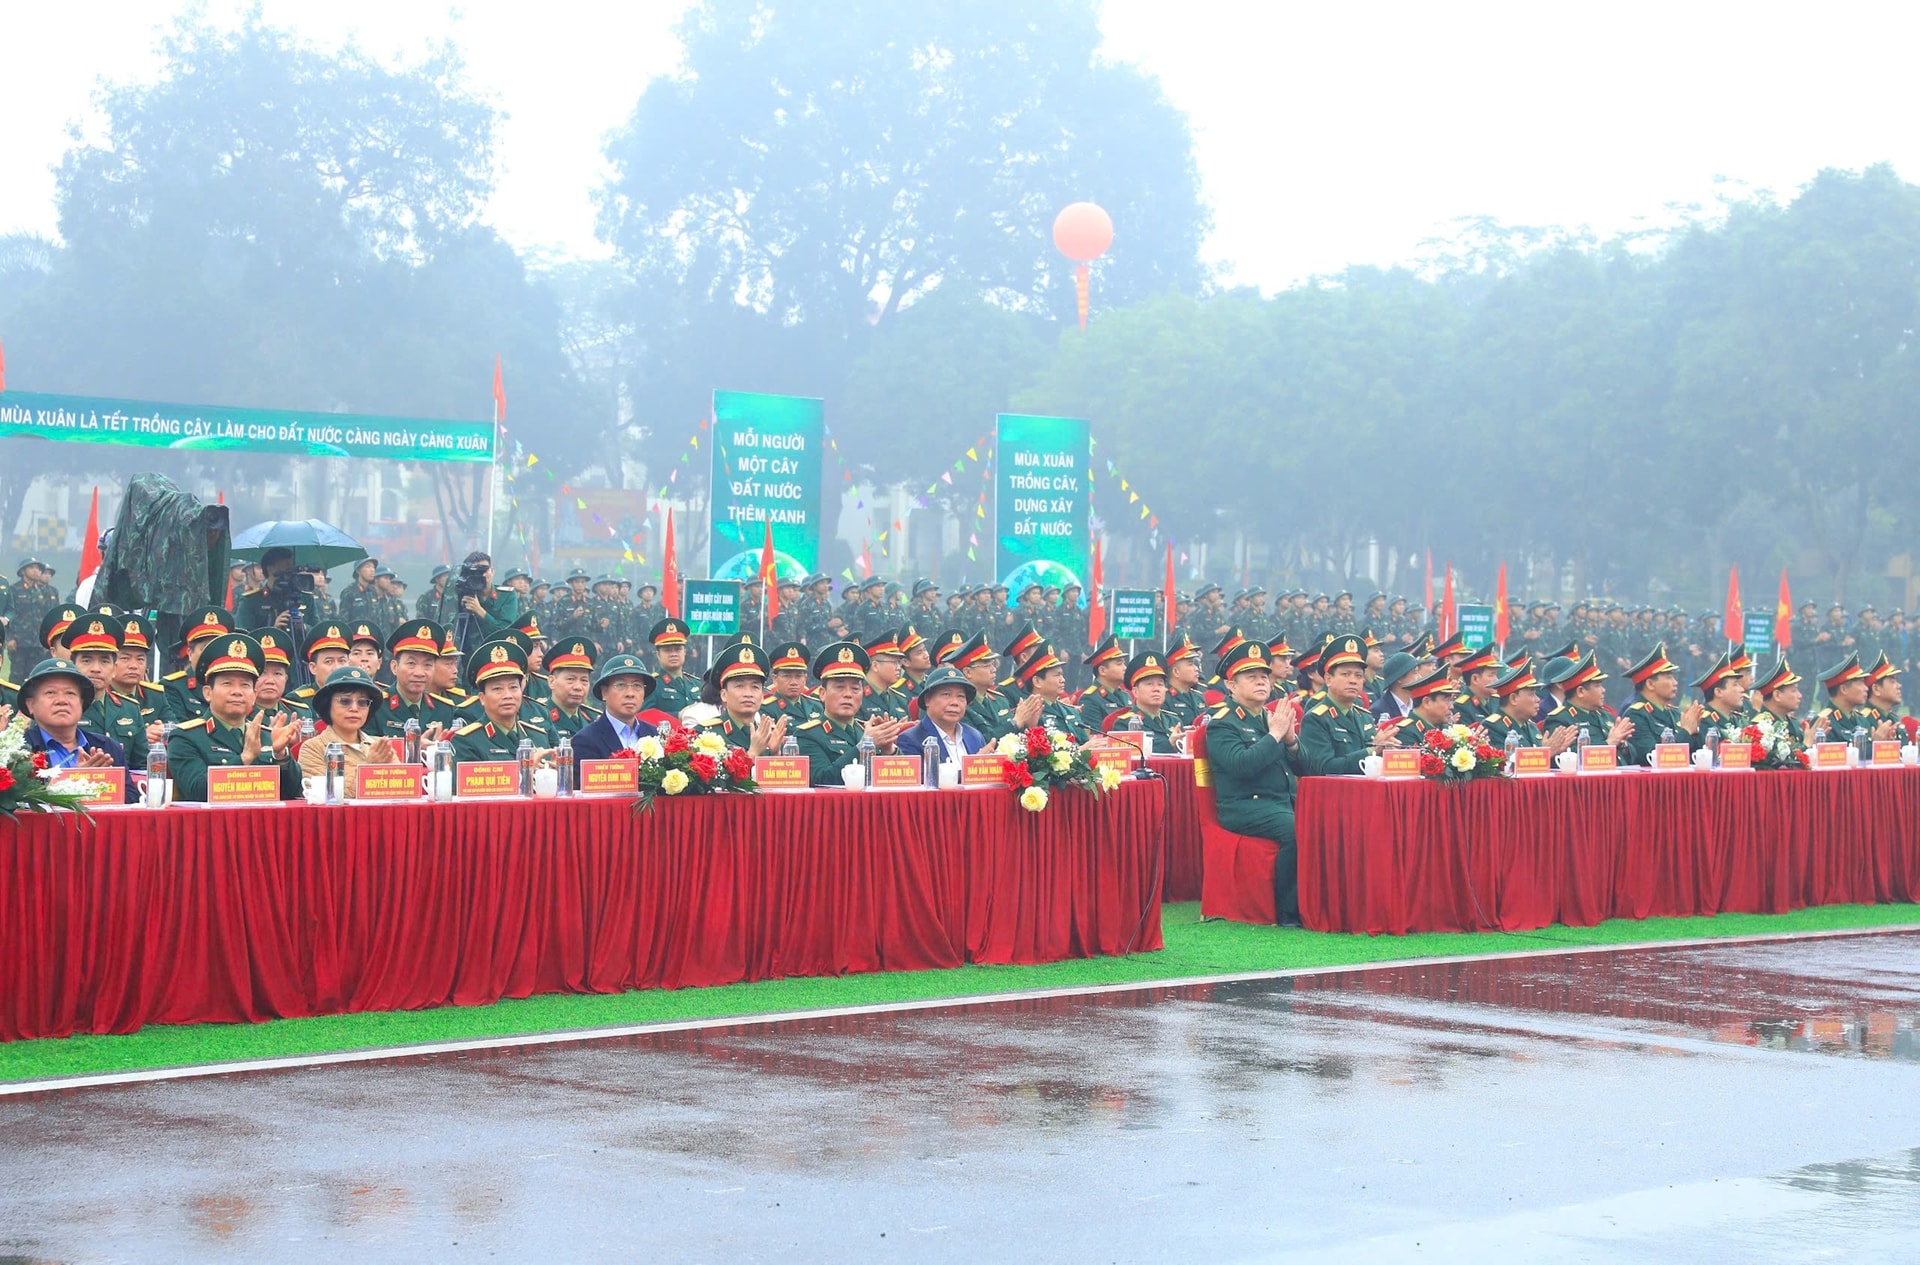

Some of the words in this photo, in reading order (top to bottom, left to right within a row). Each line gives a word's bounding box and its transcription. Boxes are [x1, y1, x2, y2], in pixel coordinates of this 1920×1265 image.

[1, 405, 33, 424] MÙA
[37, 408, 76, 427] XUÂN
[80, 410, 98, 429] LÀ
[102, 409, 129, 431] TẾT
[132, 412, 180, 434] TRỒNG
[184, 418, 213, 438] CÂY,
[217, 420, 244, 438] LÀM
[248, 424, 276, 440] CHO
[279, 421, 304, 441] ĐẤT
[307, 426, 342, 443] NƯỚC
[346, 426, 380, 446] CÀNG
[384, 428, 416, 447] NGÀY
[420, 430, 453, 448] CÀNG
[457, 433, 488, 450] XUÂN
[733, 427, 759, 447] MỖI
[762, 432, 805, 451] NGƯỜI
[738, 455, 768, 475] MỘT
[771, 457, 798, 475] CÂY
[1014, 450, 1040, 466] MÙA
[1043, 452, 1074, 468] XUÂN
[733, 477, 761, 496] ĐẤT
[764, 482, 802, 500] NƯỚC
[1053, 475, 1078, 493] CÂY,
[728, 504, 766, 522] THÊM
[769, 508, 806, 524] XANH
[1014, 498, 1048, 514] DỰNG
[1050, 497, 1073, 513] XÂY
[1014, 516, 1038, 535] ĐẤT
[1040, 520, 1072, 536] NƯỚC
[366, 776, 388, 788] NGUYỄN
[466, 776, 484, 788] PHẠM
[588, 771, 607, 782] NGUYỄN
[213, 780, 235, 792] NGUYỄN
